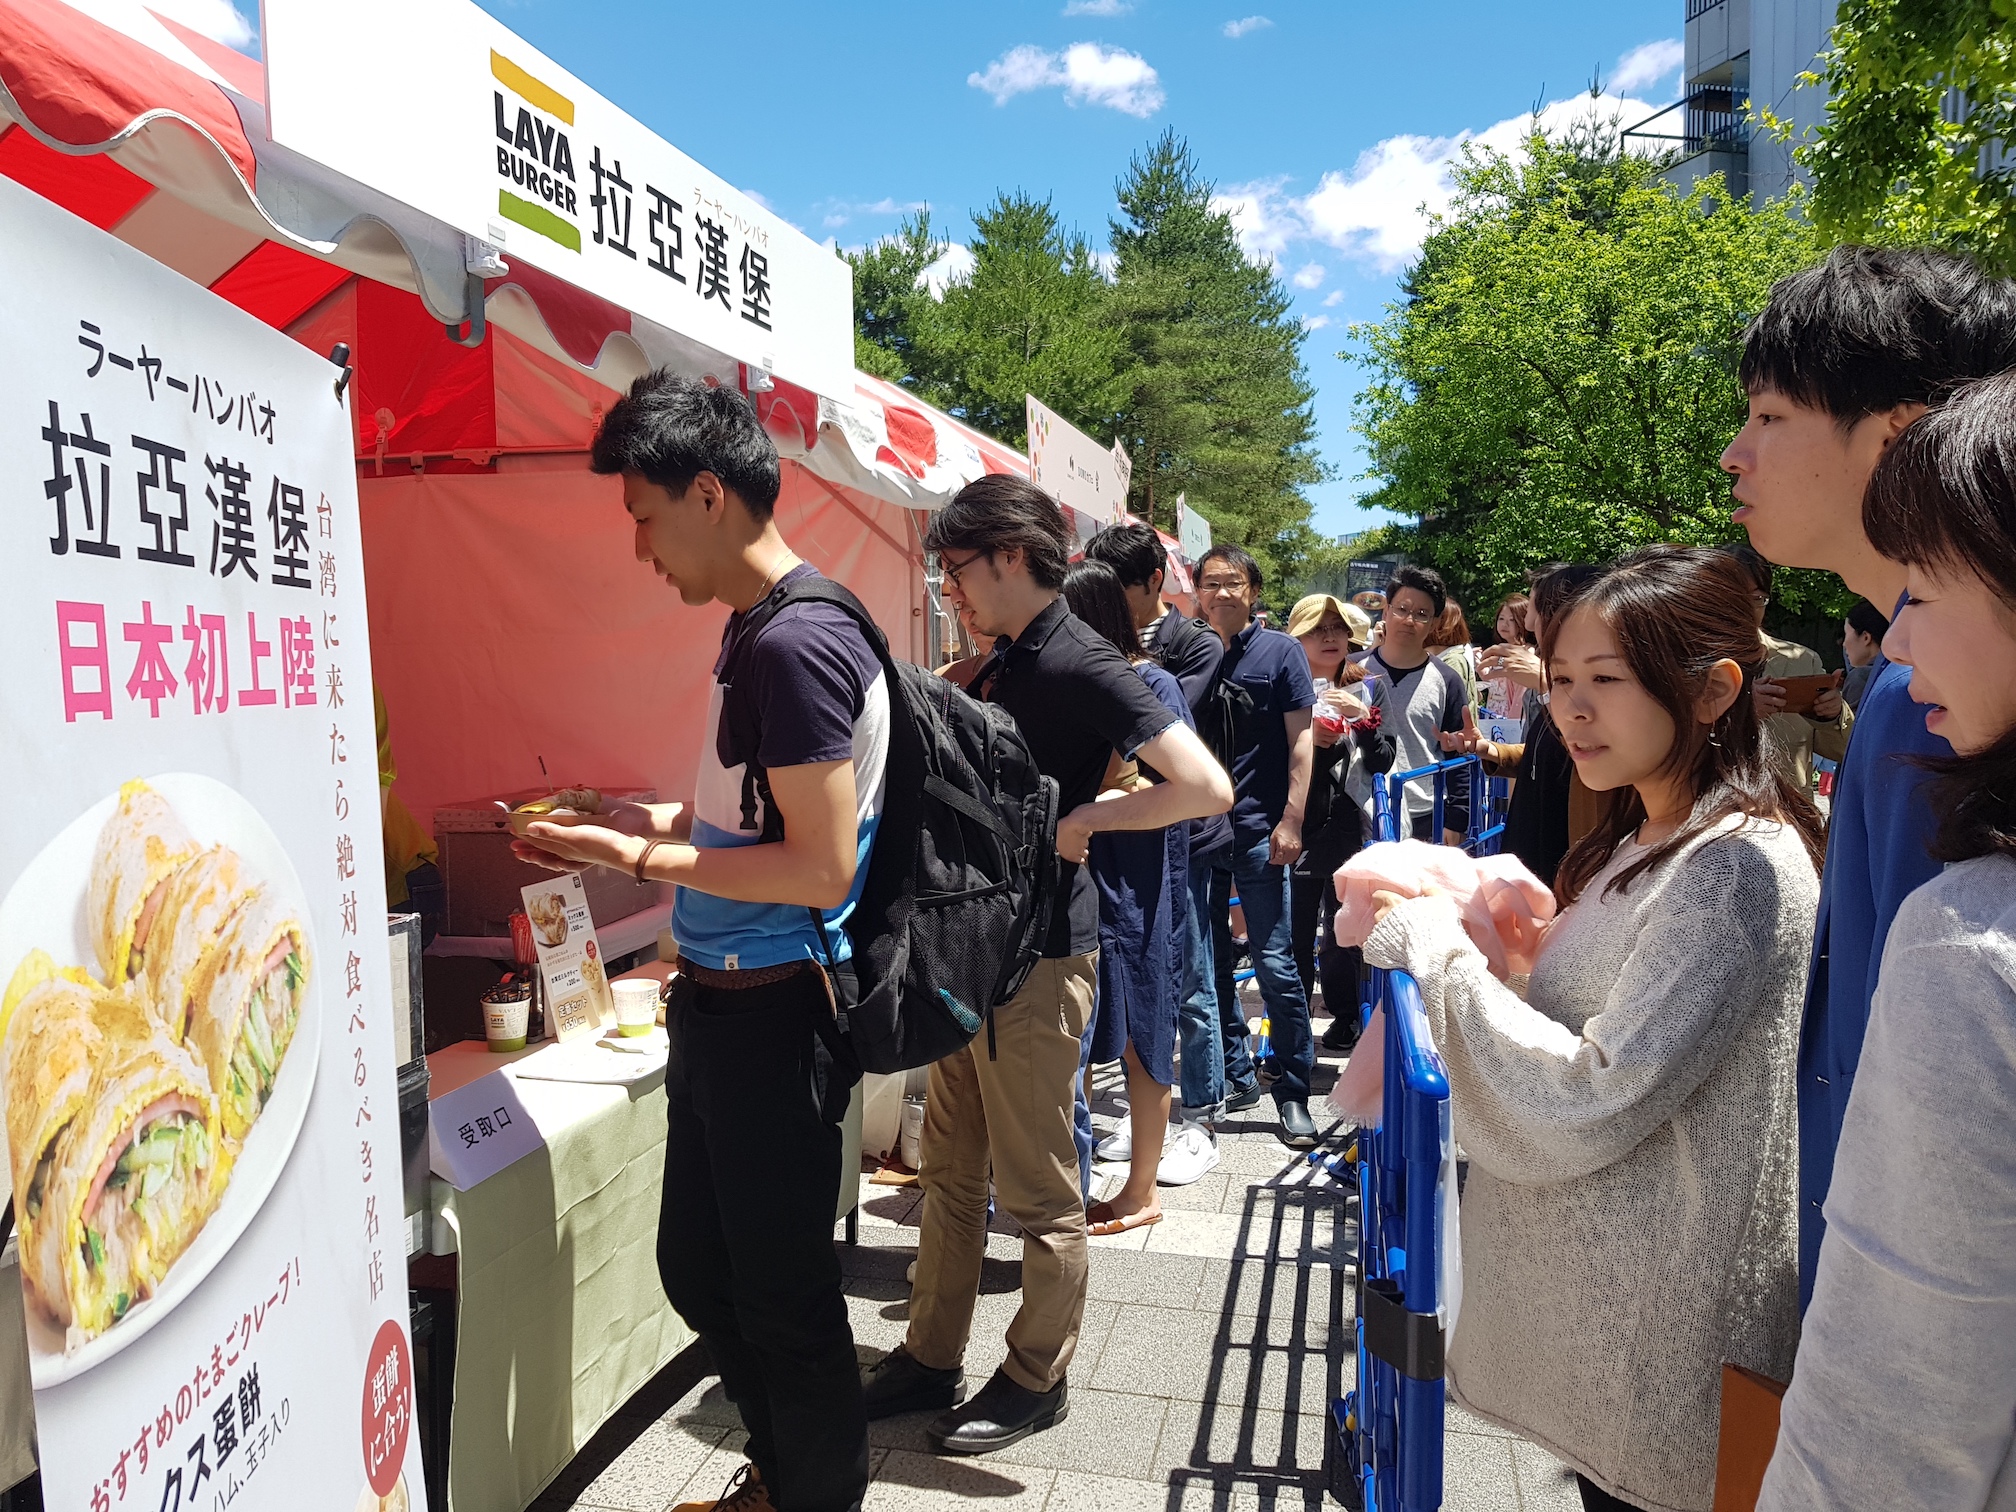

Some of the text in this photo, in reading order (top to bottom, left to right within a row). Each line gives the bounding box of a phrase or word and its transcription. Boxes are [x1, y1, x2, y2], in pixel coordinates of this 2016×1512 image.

[494, 90, 576, 183] LAYA
[496, 145, 578, 216] BURGER
[589, 145, 773, 332] 拉亞漢堡
[693, 186, 770, 249] ラーヤーハンバオ
[78, 319, 277, 445] ラーヤーハンバオ
[41, 399, 313, 589] 拉亞漢堡
[55, 599, 318, 723] 日本初上陸
[316, 491, 385, 1305] 台湾に来たら絶対食べるべき名店
[557, 995, 588, 1018] 定番セット
[457, 1106, 513, 1150] 受取口
[371, 1344, 400, 1418] 蛋餅
[369, 1386, 410, 1478] に合う!
